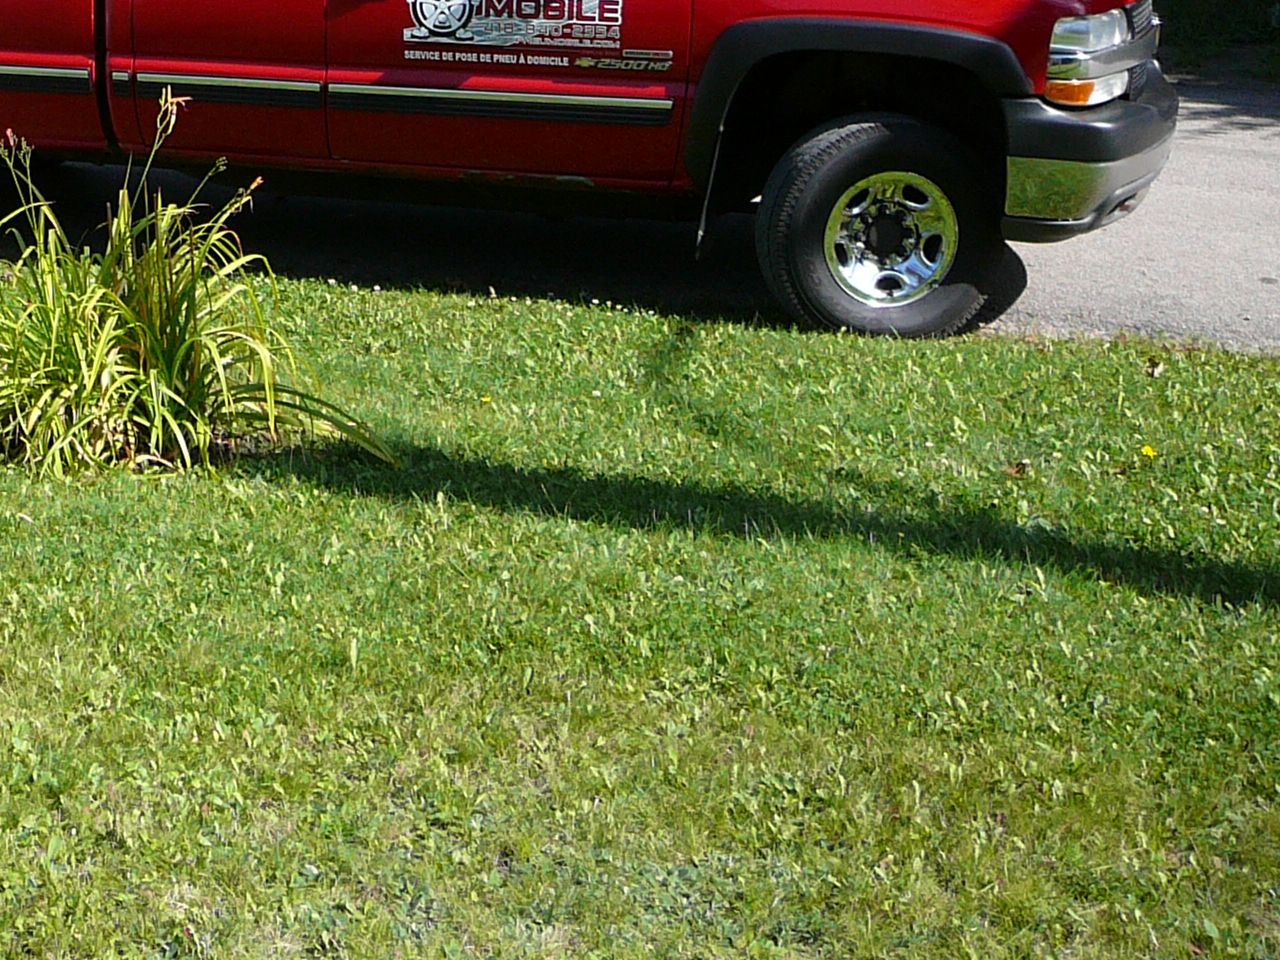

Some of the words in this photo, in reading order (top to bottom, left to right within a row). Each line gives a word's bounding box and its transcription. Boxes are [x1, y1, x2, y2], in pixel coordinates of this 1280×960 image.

[404, 50, 440, 60] SERVICE
[441, 52, 454, 61] DE
[455, 52, 478, 62] POSE
[480, 53, 492, 62] DE
[493, 54, 517, 64] PNEU
[527, 55, 569, 66] DOMICILE
[596, 58, 648, 70] 2500
